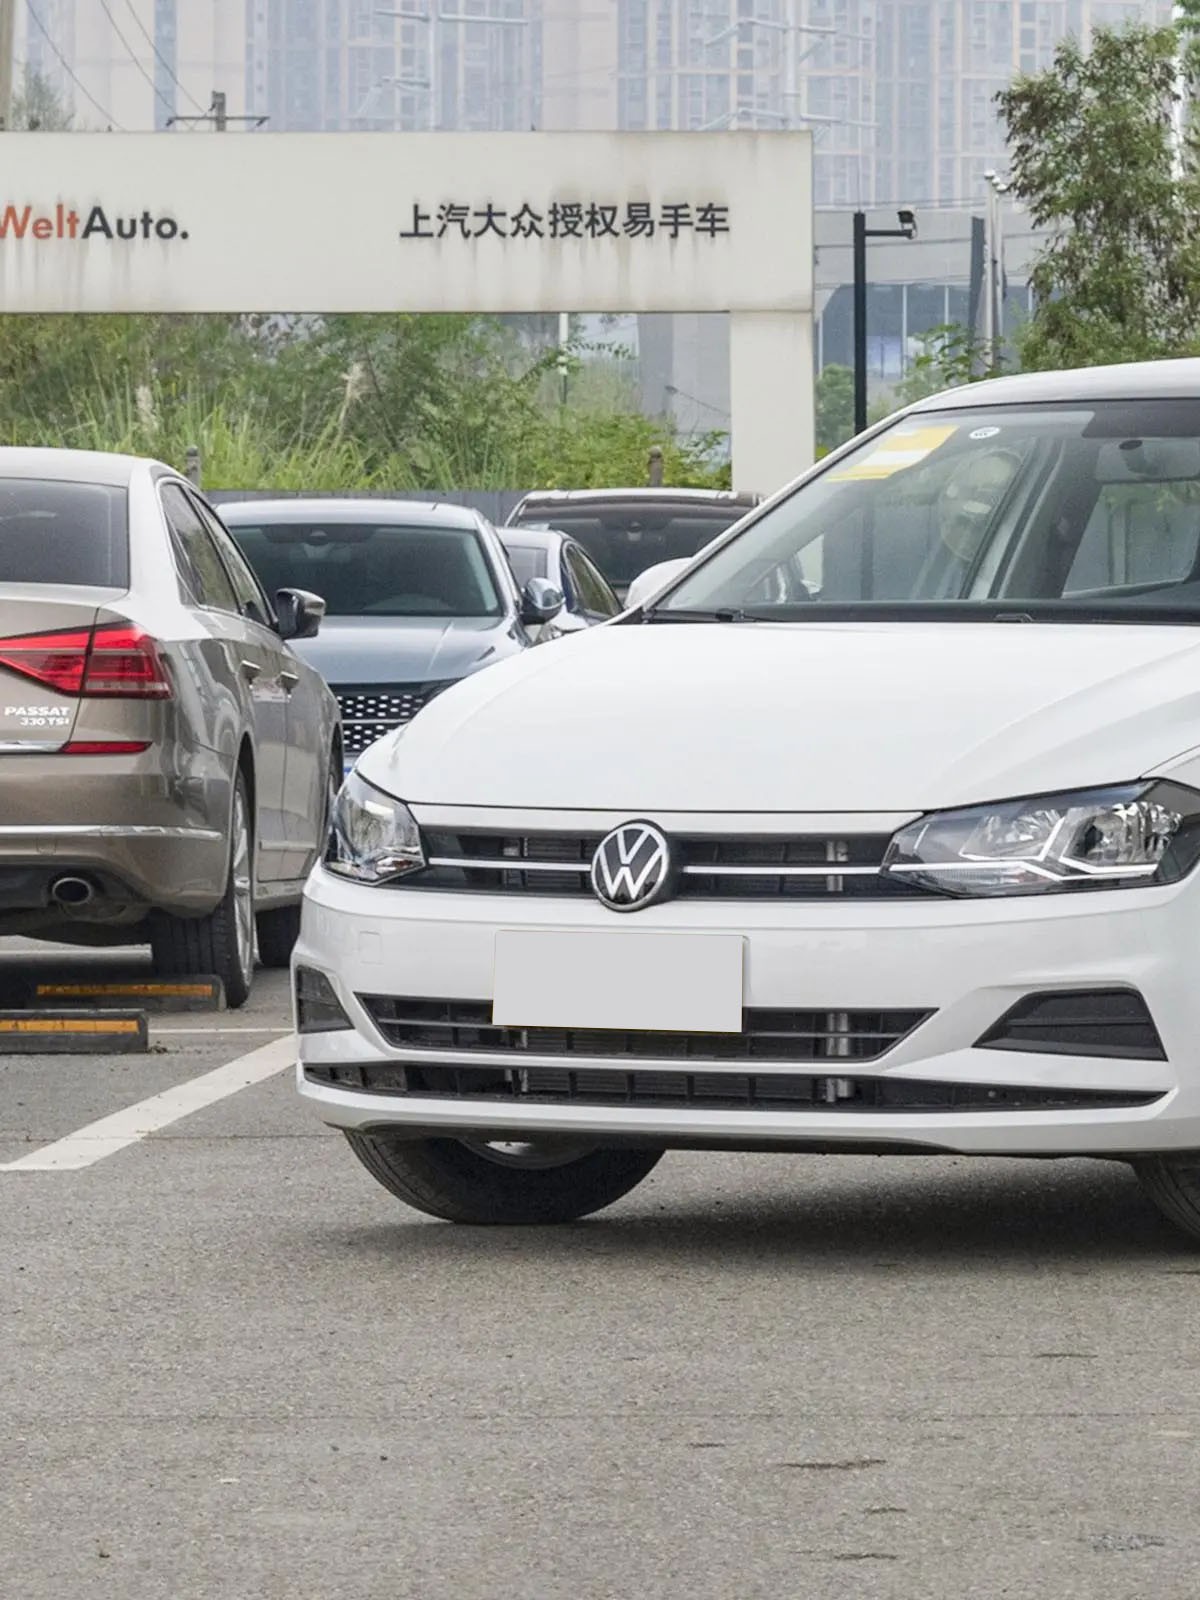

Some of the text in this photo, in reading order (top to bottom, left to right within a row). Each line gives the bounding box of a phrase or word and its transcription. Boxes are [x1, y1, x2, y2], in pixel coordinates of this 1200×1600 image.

[0, 203, 189, 240] WeltAuto.
[400, 202, 730, 239] 上汽大众授权易手车
[4, 706, 71, 716] PASSAT
